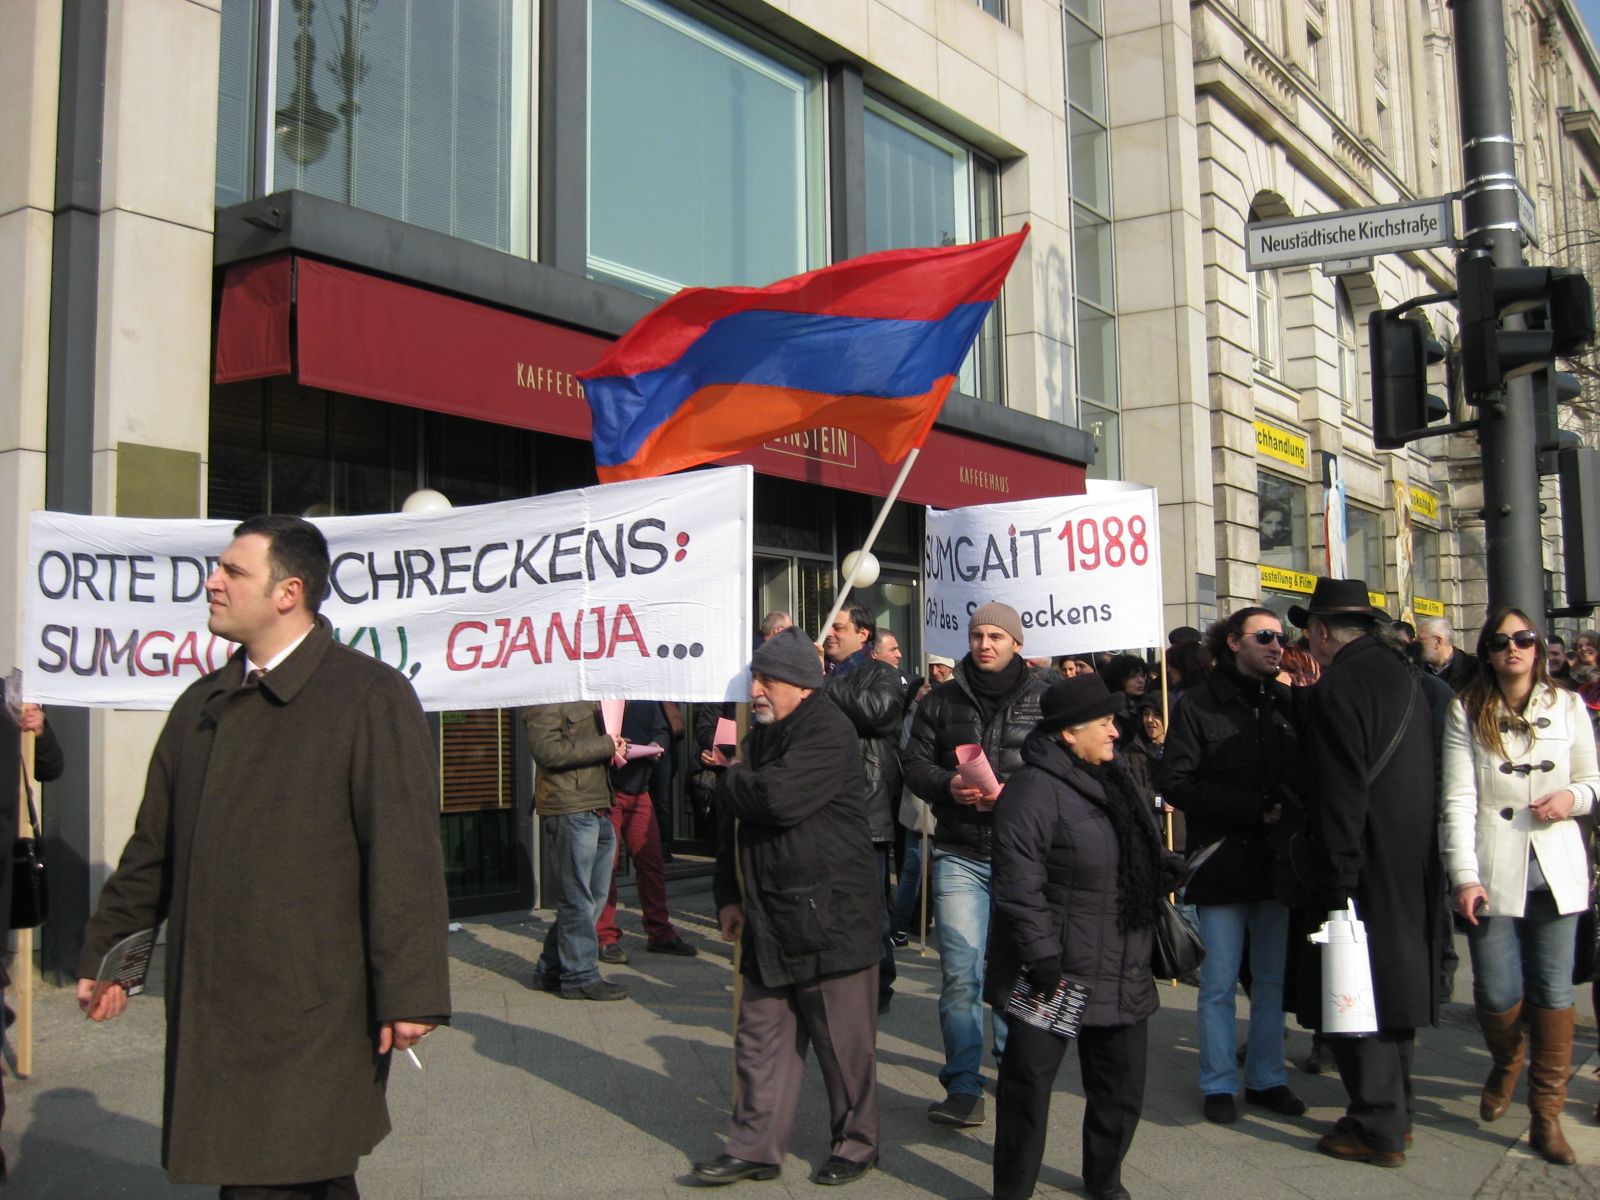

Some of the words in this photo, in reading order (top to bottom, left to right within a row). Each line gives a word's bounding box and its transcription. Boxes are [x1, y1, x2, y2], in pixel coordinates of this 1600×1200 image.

[1261, 228, 1356, 253] Neustädtische
[1359, 213, 1438, 240] Kirchstraße
[517, 362, 585, 400] KAFFEEH
[1256, 428, 1305, 465] chhandlung
[959, 465, 1010, 493] KAFFEEHAUS
[38, 550, 156, 603] ORTE
[325, 518, 690, 604] CHRECKENS:
[1057, 514, 1149, 572] 1988
[940, 600, 959, 632] des
[38, 624, 233, 677] SUMGAI
[446, 603, 704, 672] GJANJA...
